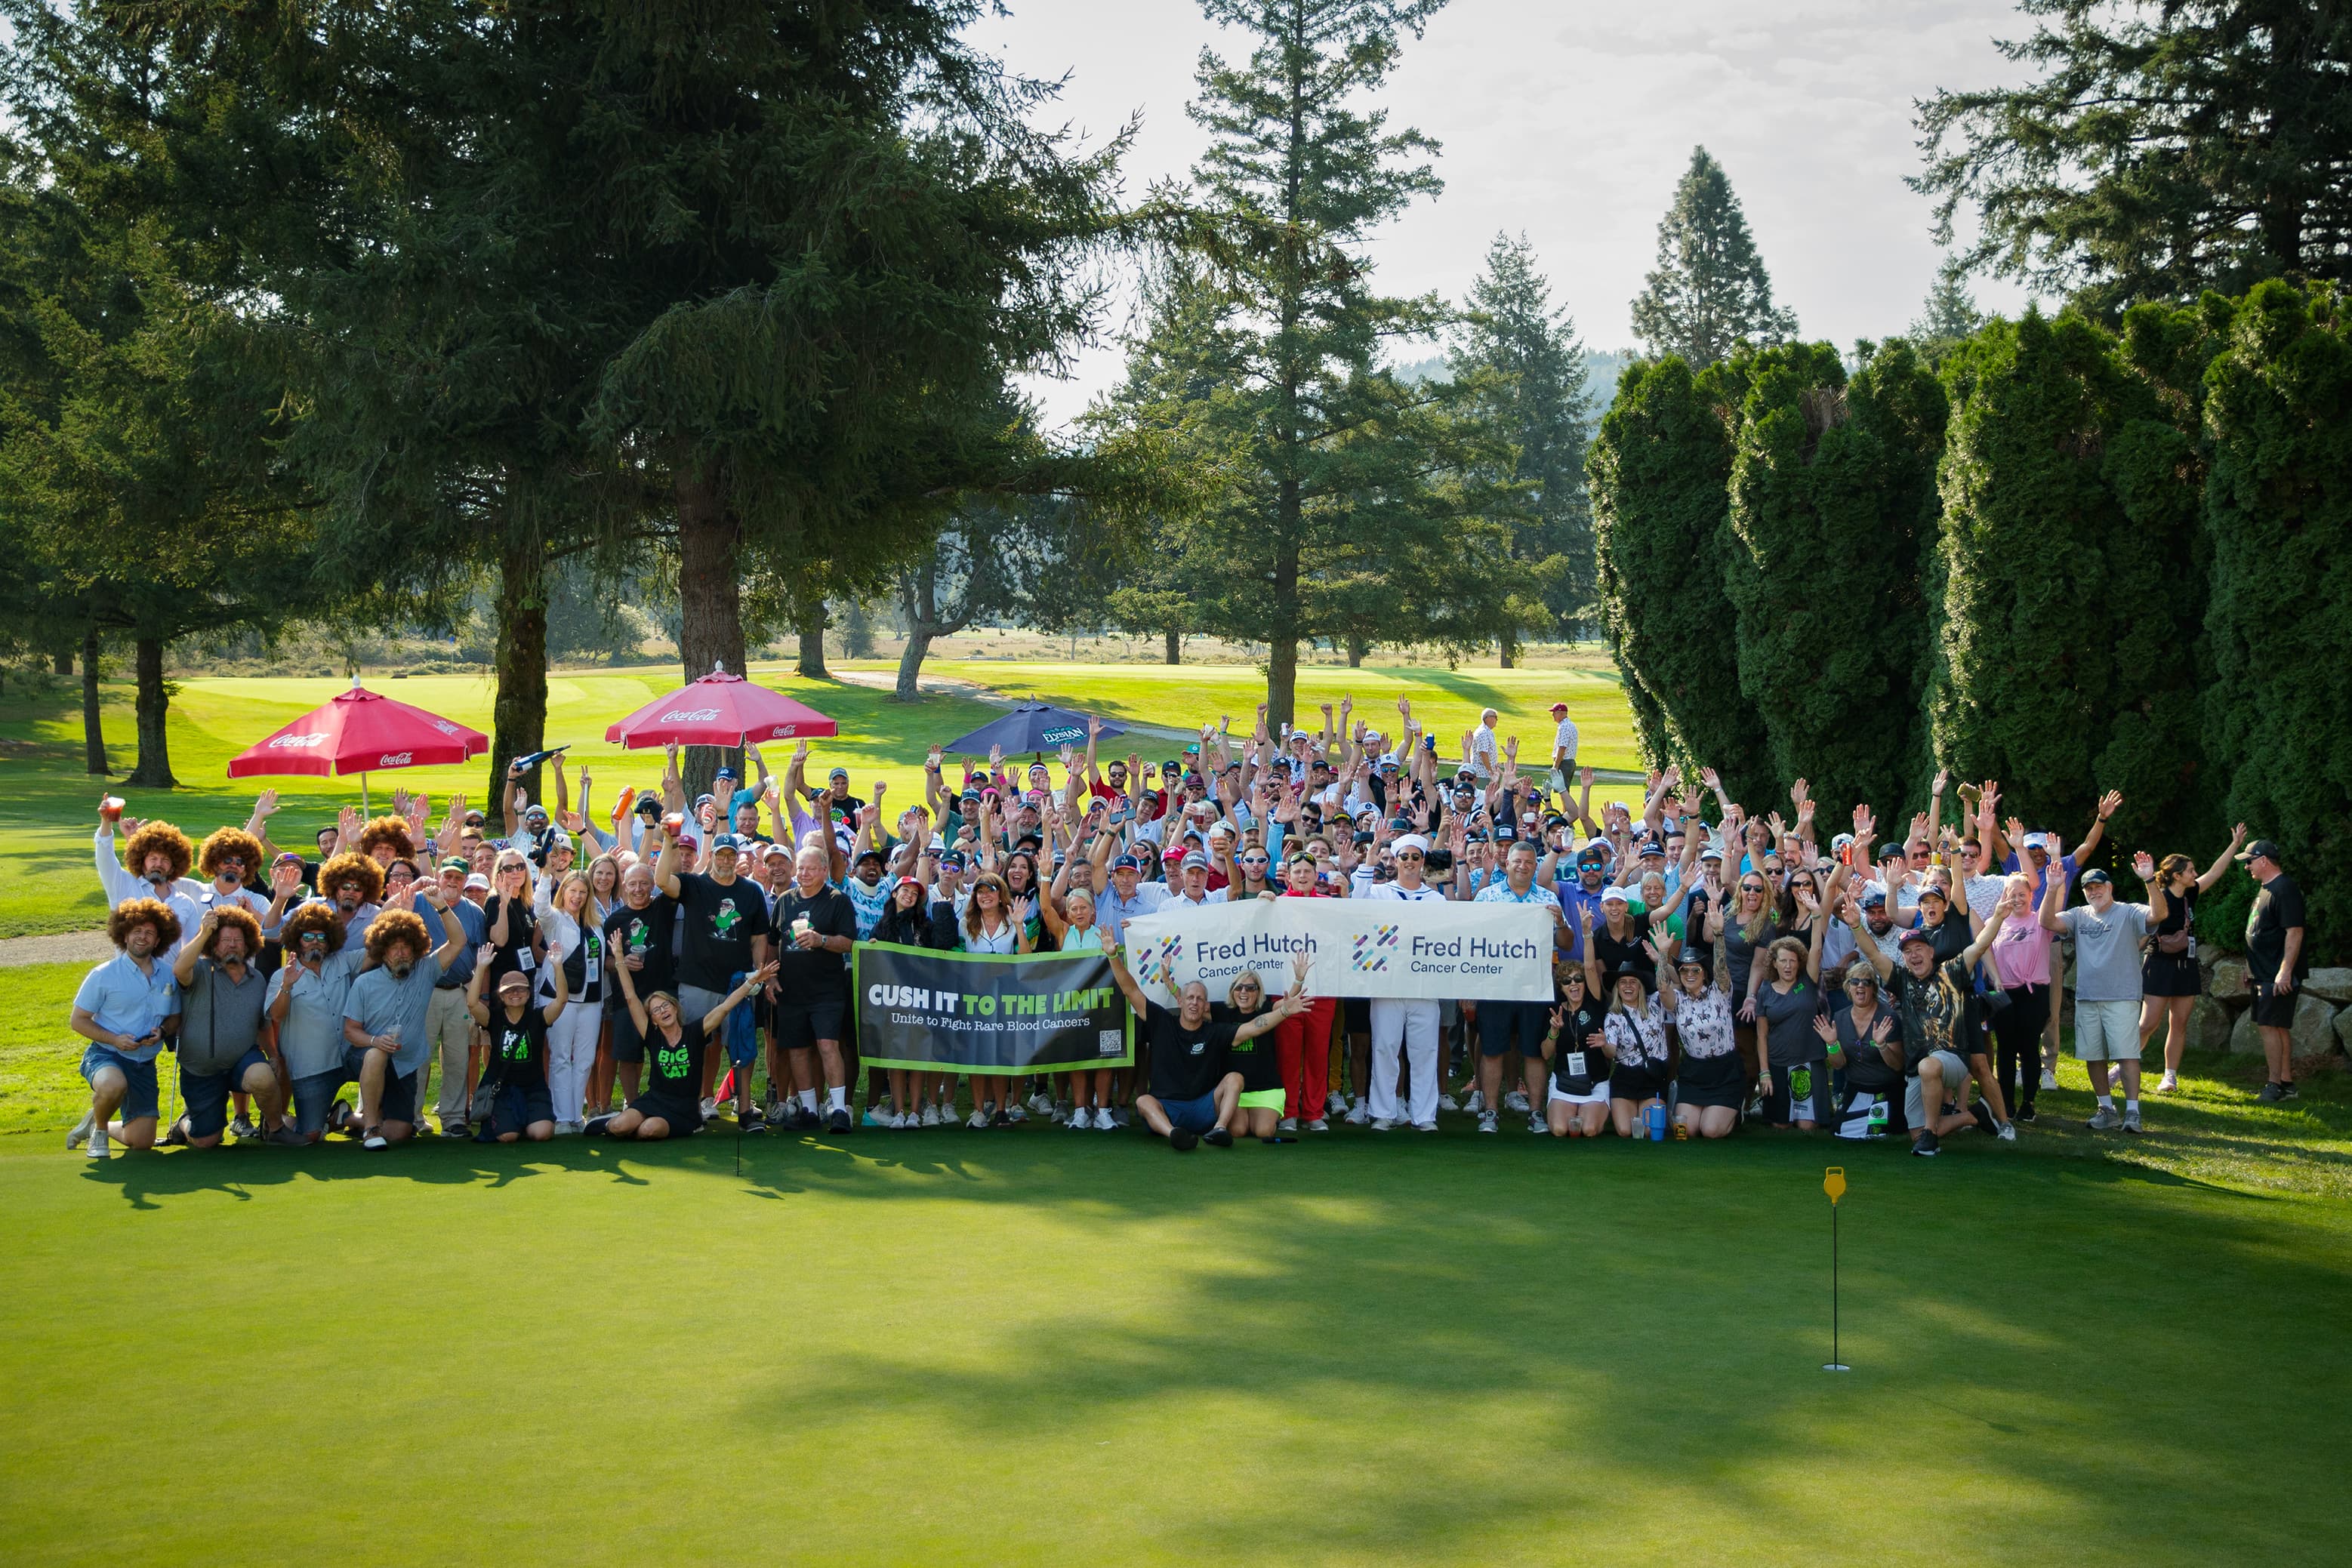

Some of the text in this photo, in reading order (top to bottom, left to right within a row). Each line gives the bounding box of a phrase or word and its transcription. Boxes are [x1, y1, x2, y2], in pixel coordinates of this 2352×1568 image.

[1043, 727, 1084, 742] ELYSIAN
[1197, 932, 1317, 962] Fred Hutch
[1413, 936, 1537, 959] Fred Hutch
[1198, 958, 1284, 978] Cancer Center
[1410, 961, 1503, 974] Cancer Center
[868, 984, 1114, 1015] CUSH IT TO THE LIMIT
[891, 1012, 1090, 1031] Unite to Fight Rare Blood Cancers
[658, 1048, 689, 1063] BIG
[661, 1064, 690, 1078] CAT
